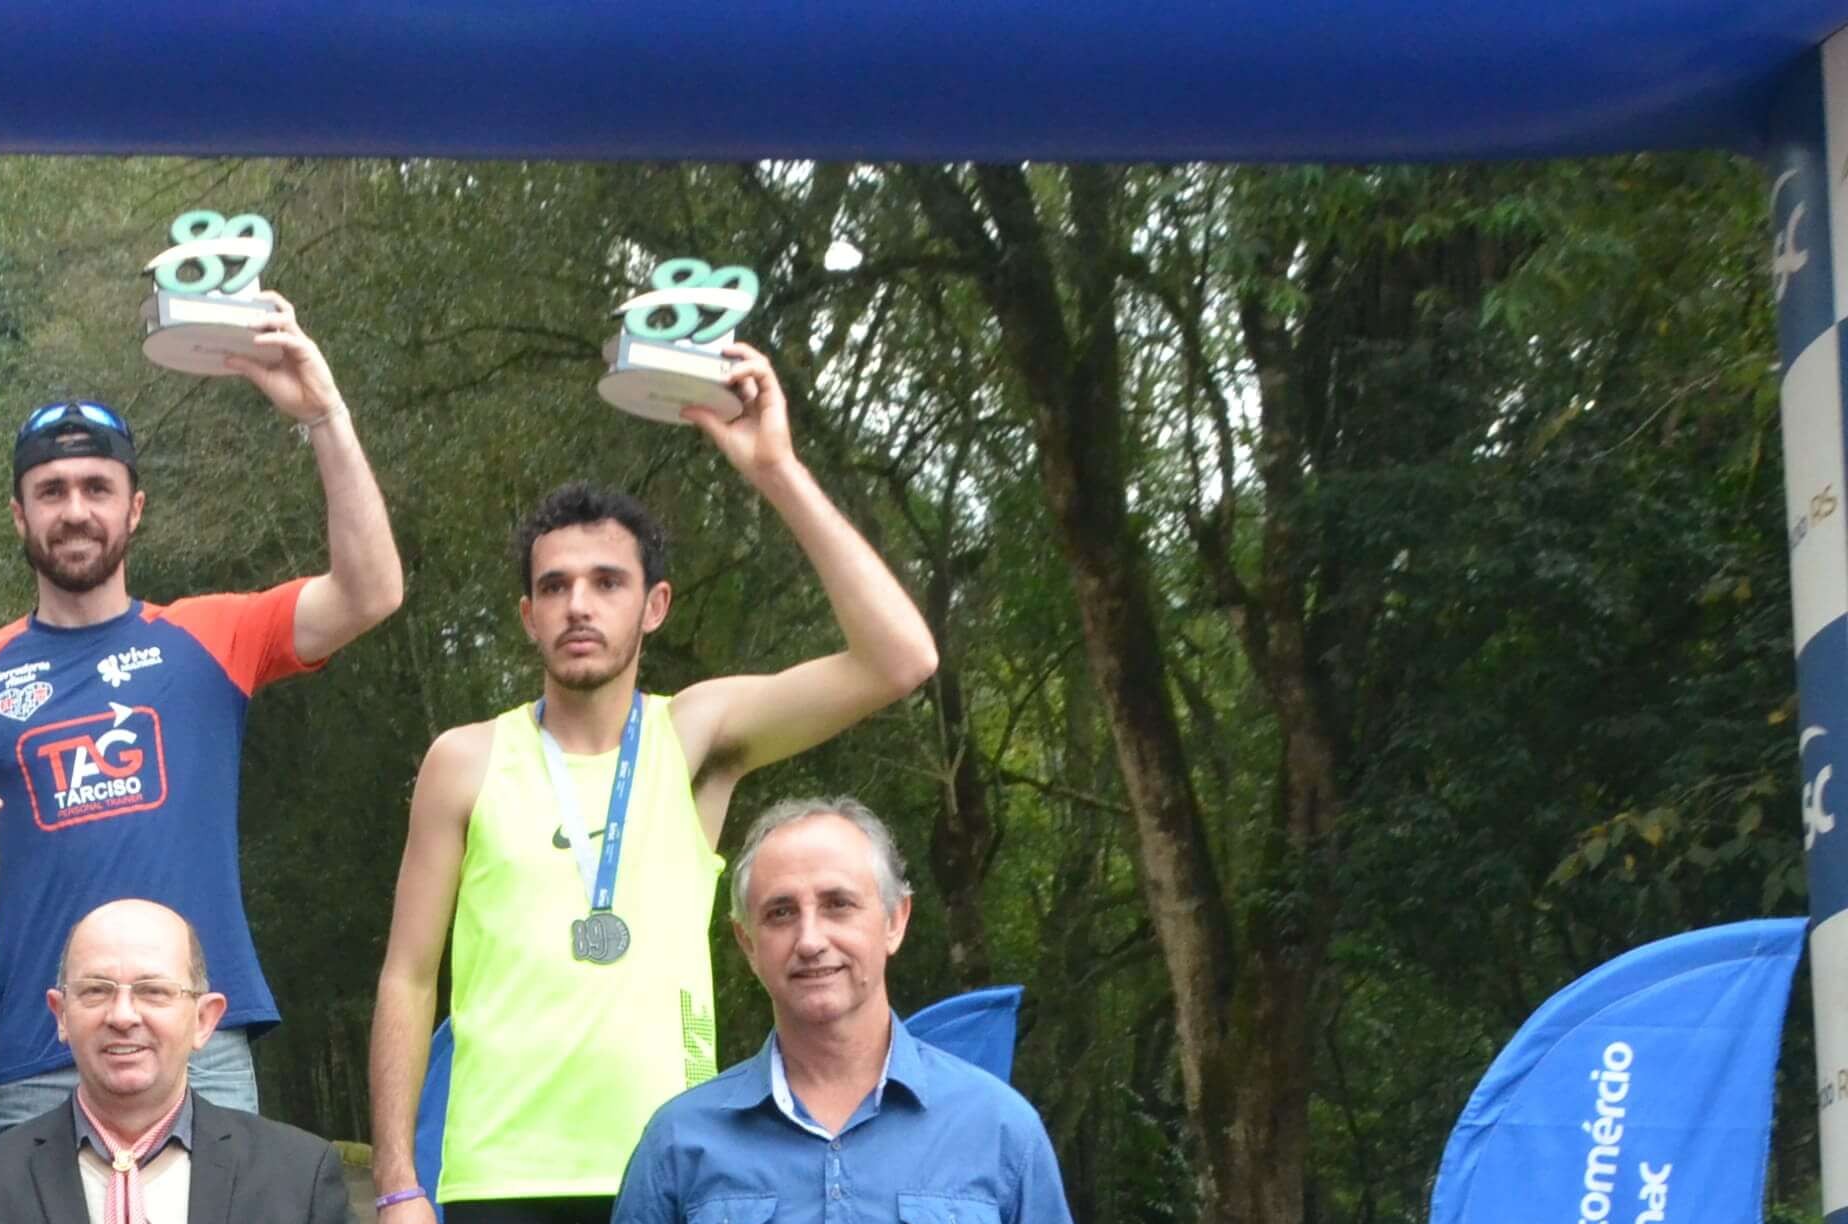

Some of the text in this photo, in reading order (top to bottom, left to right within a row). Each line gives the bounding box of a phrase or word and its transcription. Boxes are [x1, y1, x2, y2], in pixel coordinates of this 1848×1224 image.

[153, 208, 274, 295] 89
[622, 256, 760, 342] 89
[37, 729, 143, 792] TAG
[54, 777, 142, 809] TARCISO
